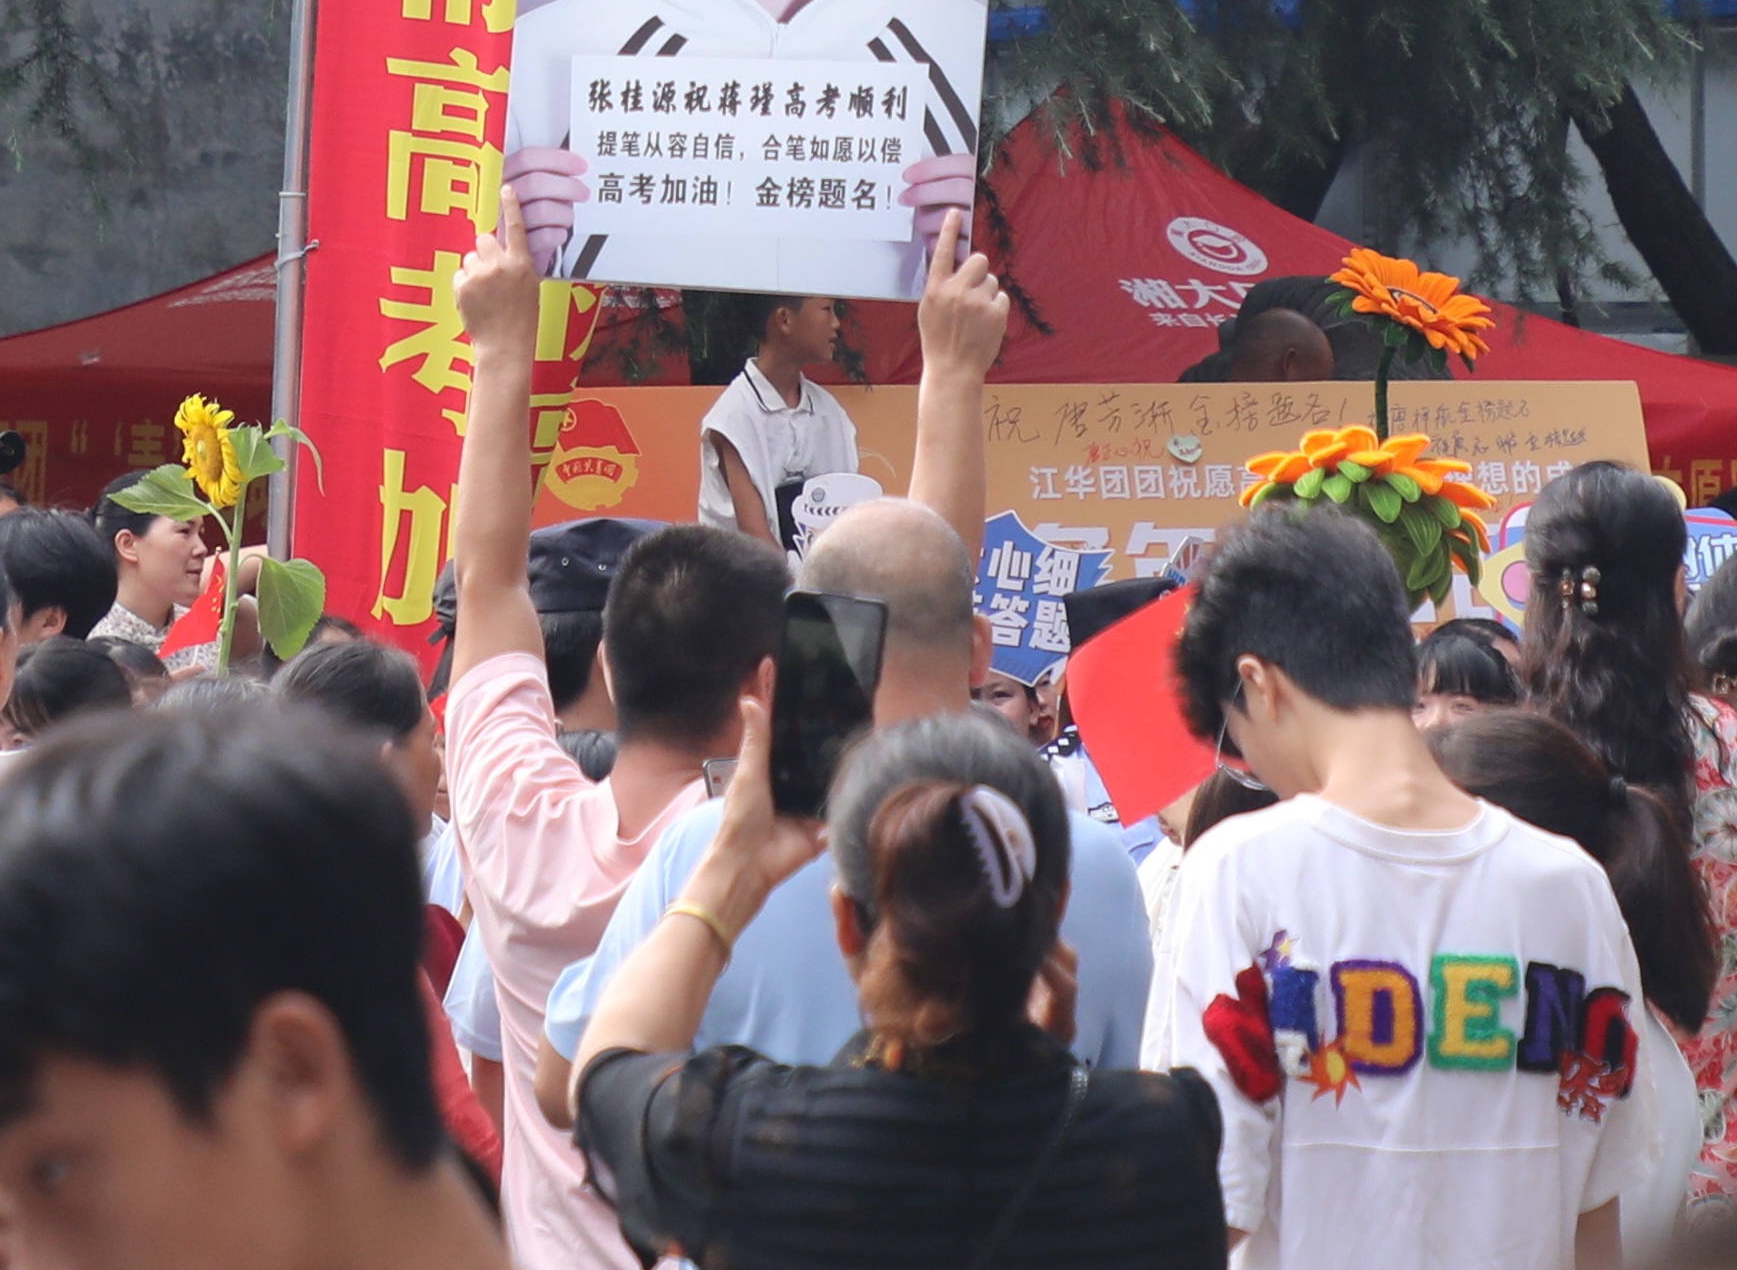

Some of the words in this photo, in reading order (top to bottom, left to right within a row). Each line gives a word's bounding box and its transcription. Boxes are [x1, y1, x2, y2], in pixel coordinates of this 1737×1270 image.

[587, 78, 909, 121] 张桂源祝蒋瑾高考顺利
[1149, 312, 1238, 328] 来自长
[975, 539, 1083, 598] 心细
[972, 593, 1072, 654] 答题
